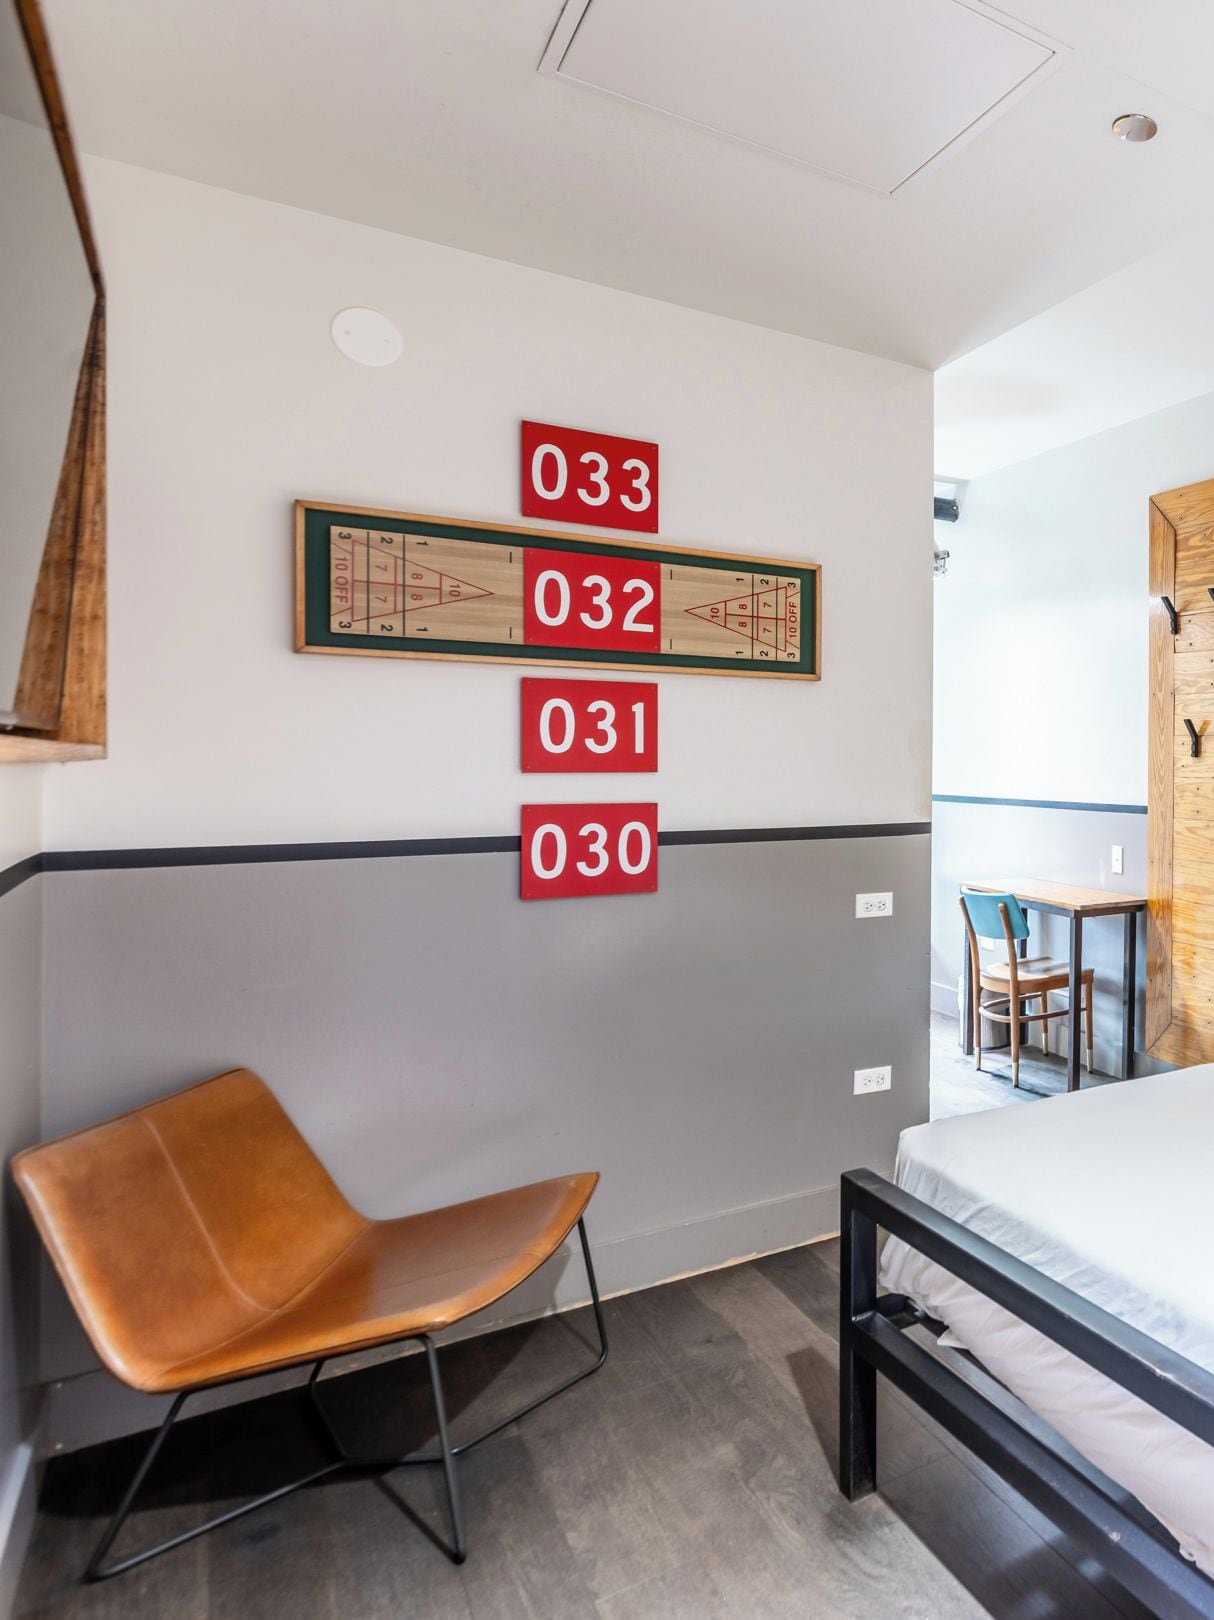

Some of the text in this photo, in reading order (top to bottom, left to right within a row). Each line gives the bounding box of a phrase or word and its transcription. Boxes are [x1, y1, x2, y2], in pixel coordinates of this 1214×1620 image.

[531, 443, 652, 512] 033
[339, 532, 352, 540] 3
[380, 536, 394, 544] 2
[375, 564, 388, 572] 7
[334, 556, 348, 604] 10 OFF
[449, 584, 461, 597] 10
[411, 593, 423, 601] 8
[534, 569, 655, 633] 032
[710, 608, 720, 620] 10
[788, 602, 798, 638] 10 OFF
[339, 621, 352, 629] 3
[380, 624, 394, 632] 2
[539, 698, 645, 754] 031
[531, 821, 651, 880] 030
